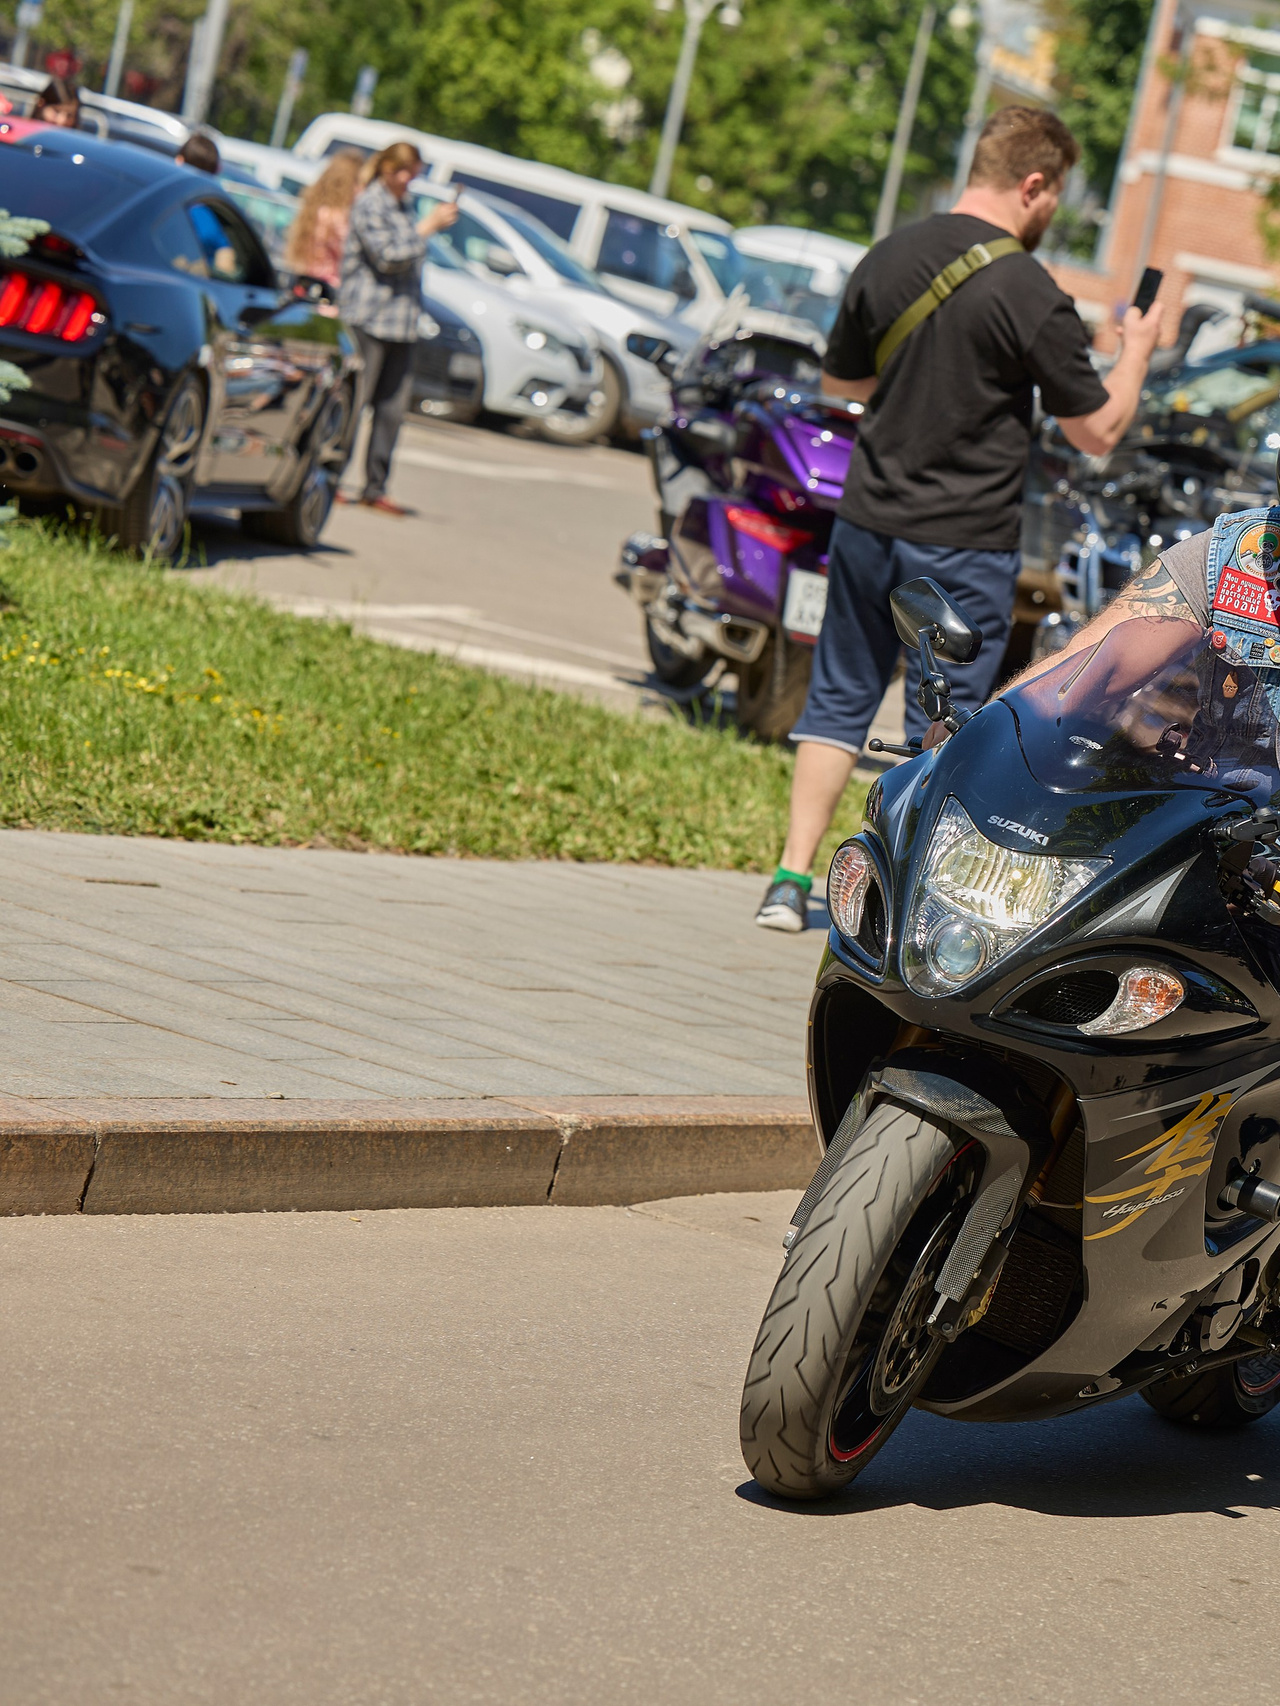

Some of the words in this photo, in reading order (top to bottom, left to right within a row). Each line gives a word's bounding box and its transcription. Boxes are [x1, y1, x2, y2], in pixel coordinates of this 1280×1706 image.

[1225, 572, 1239, 583] Мои
[1240, 580, 1265, 593] лучшие
[1220, 588, 1261, 605] настоящие
[986, 814, 1050, 847] SUZUKI
[1102, 1186, 1186, 1219] Hayabusa
